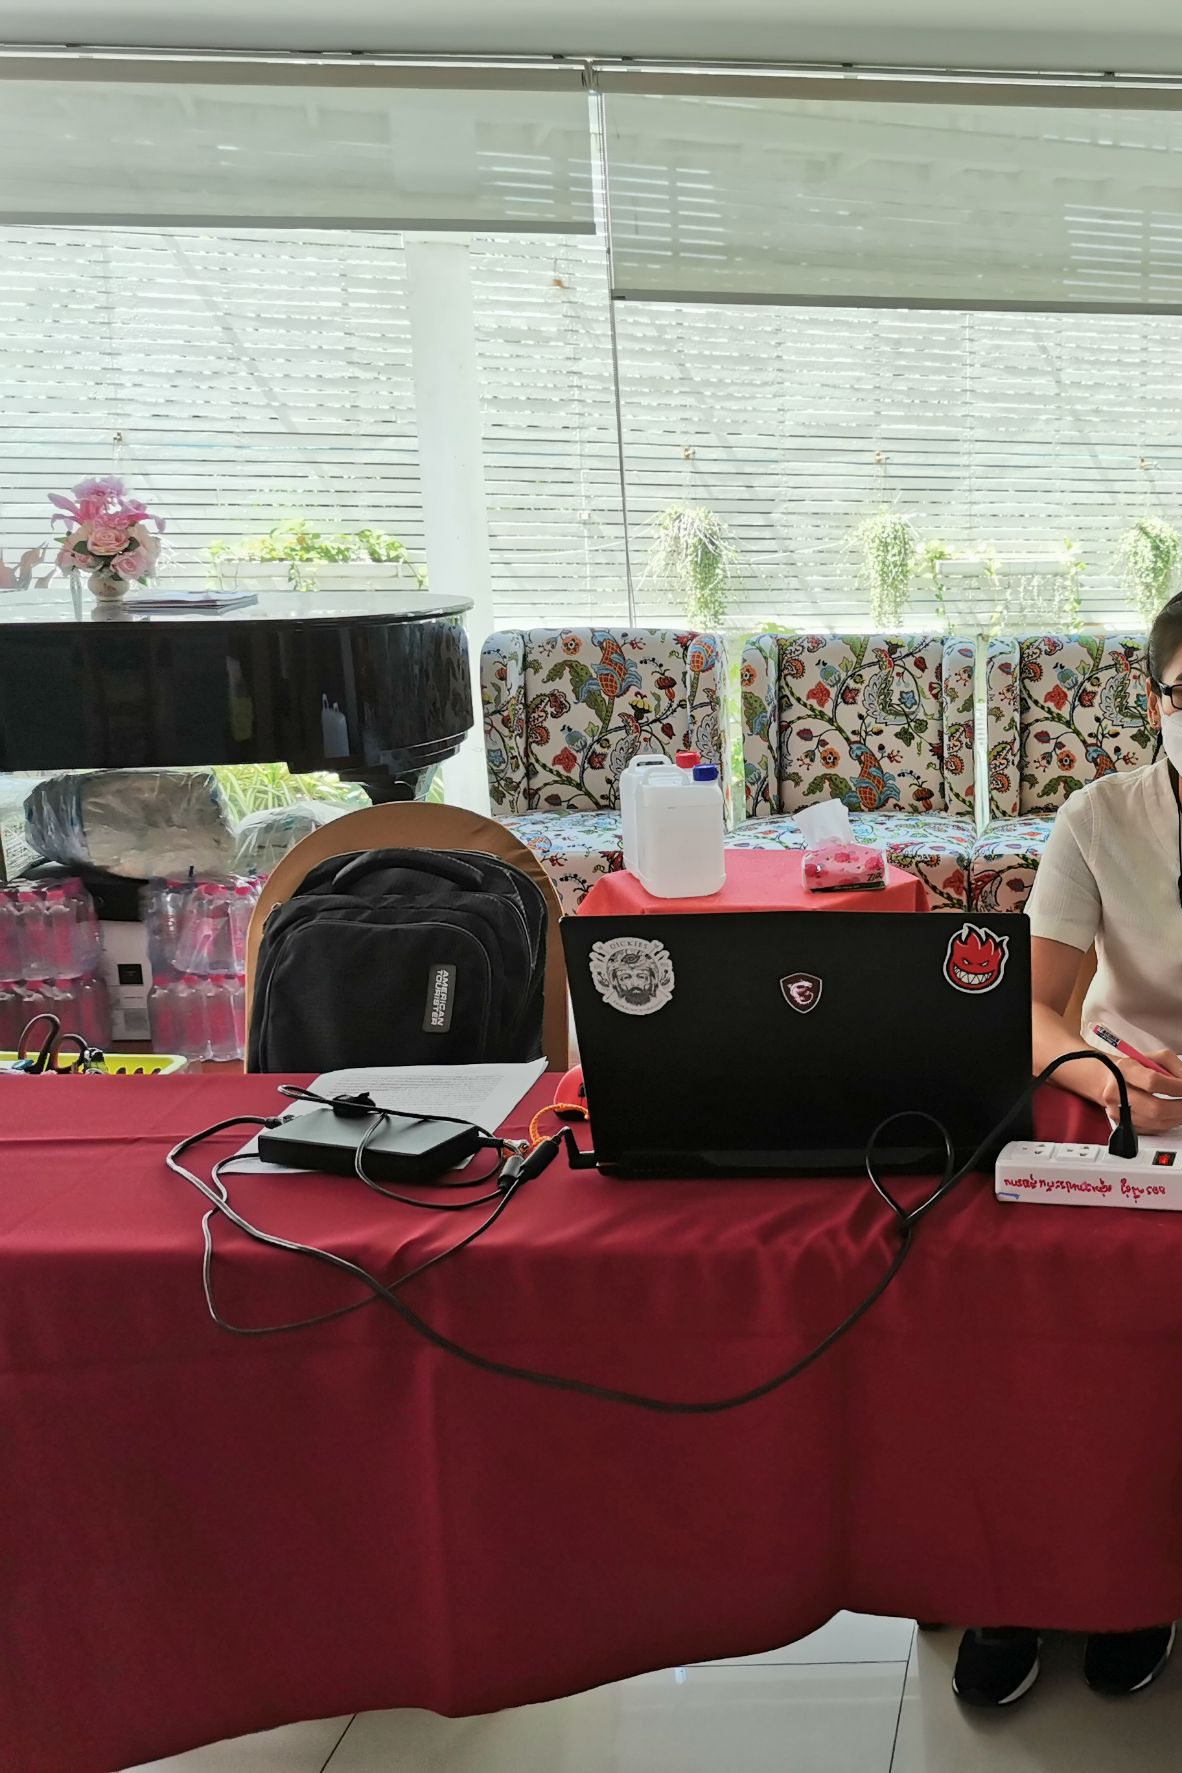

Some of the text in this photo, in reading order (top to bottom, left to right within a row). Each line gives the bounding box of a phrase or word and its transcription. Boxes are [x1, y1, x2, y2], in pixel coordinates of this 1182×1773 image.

[610, 941, 648, 950] DICKIES
[431, 969, 443, 1026] TOURISTER
[437, 969, 449, 1026] AMERICAN
